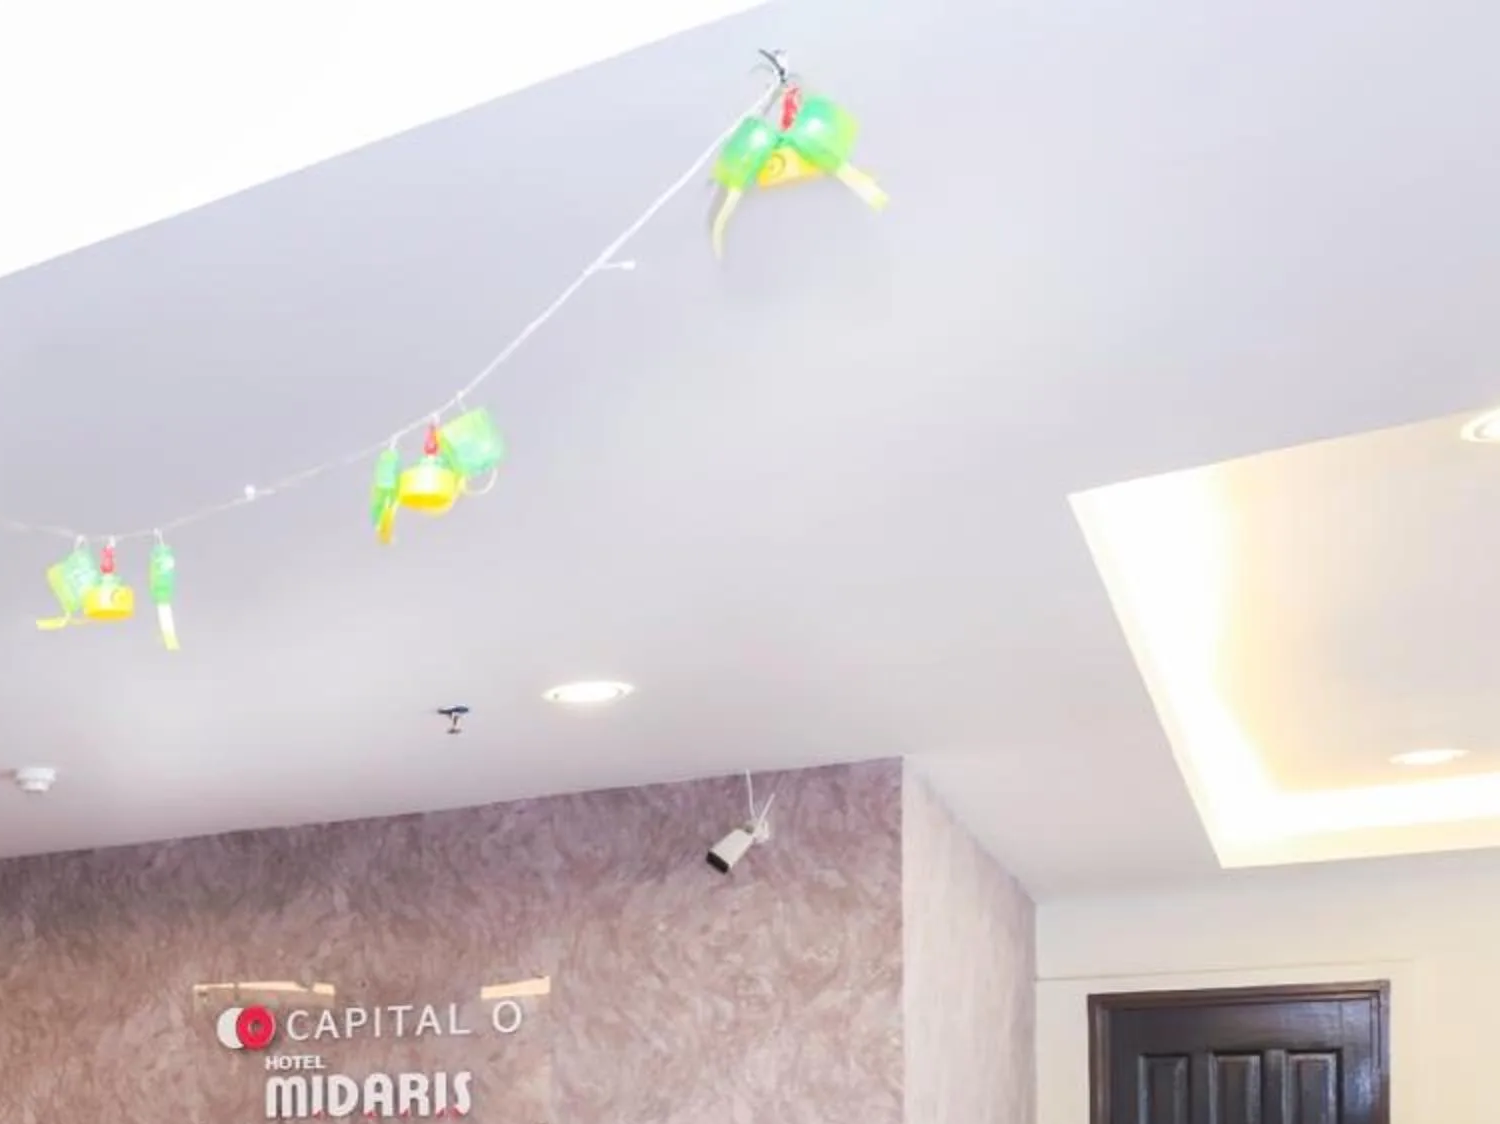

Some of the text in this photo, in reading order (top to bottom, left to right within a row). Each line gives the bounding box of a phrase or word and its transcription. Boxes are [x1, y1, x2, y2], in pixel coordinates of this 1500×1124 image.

[286, 1000, 522, 1041] CAPITAL O
[265, 1055, 325, 1070] HOTEL
[265, 1072, 472, 1118] MIDARIS
